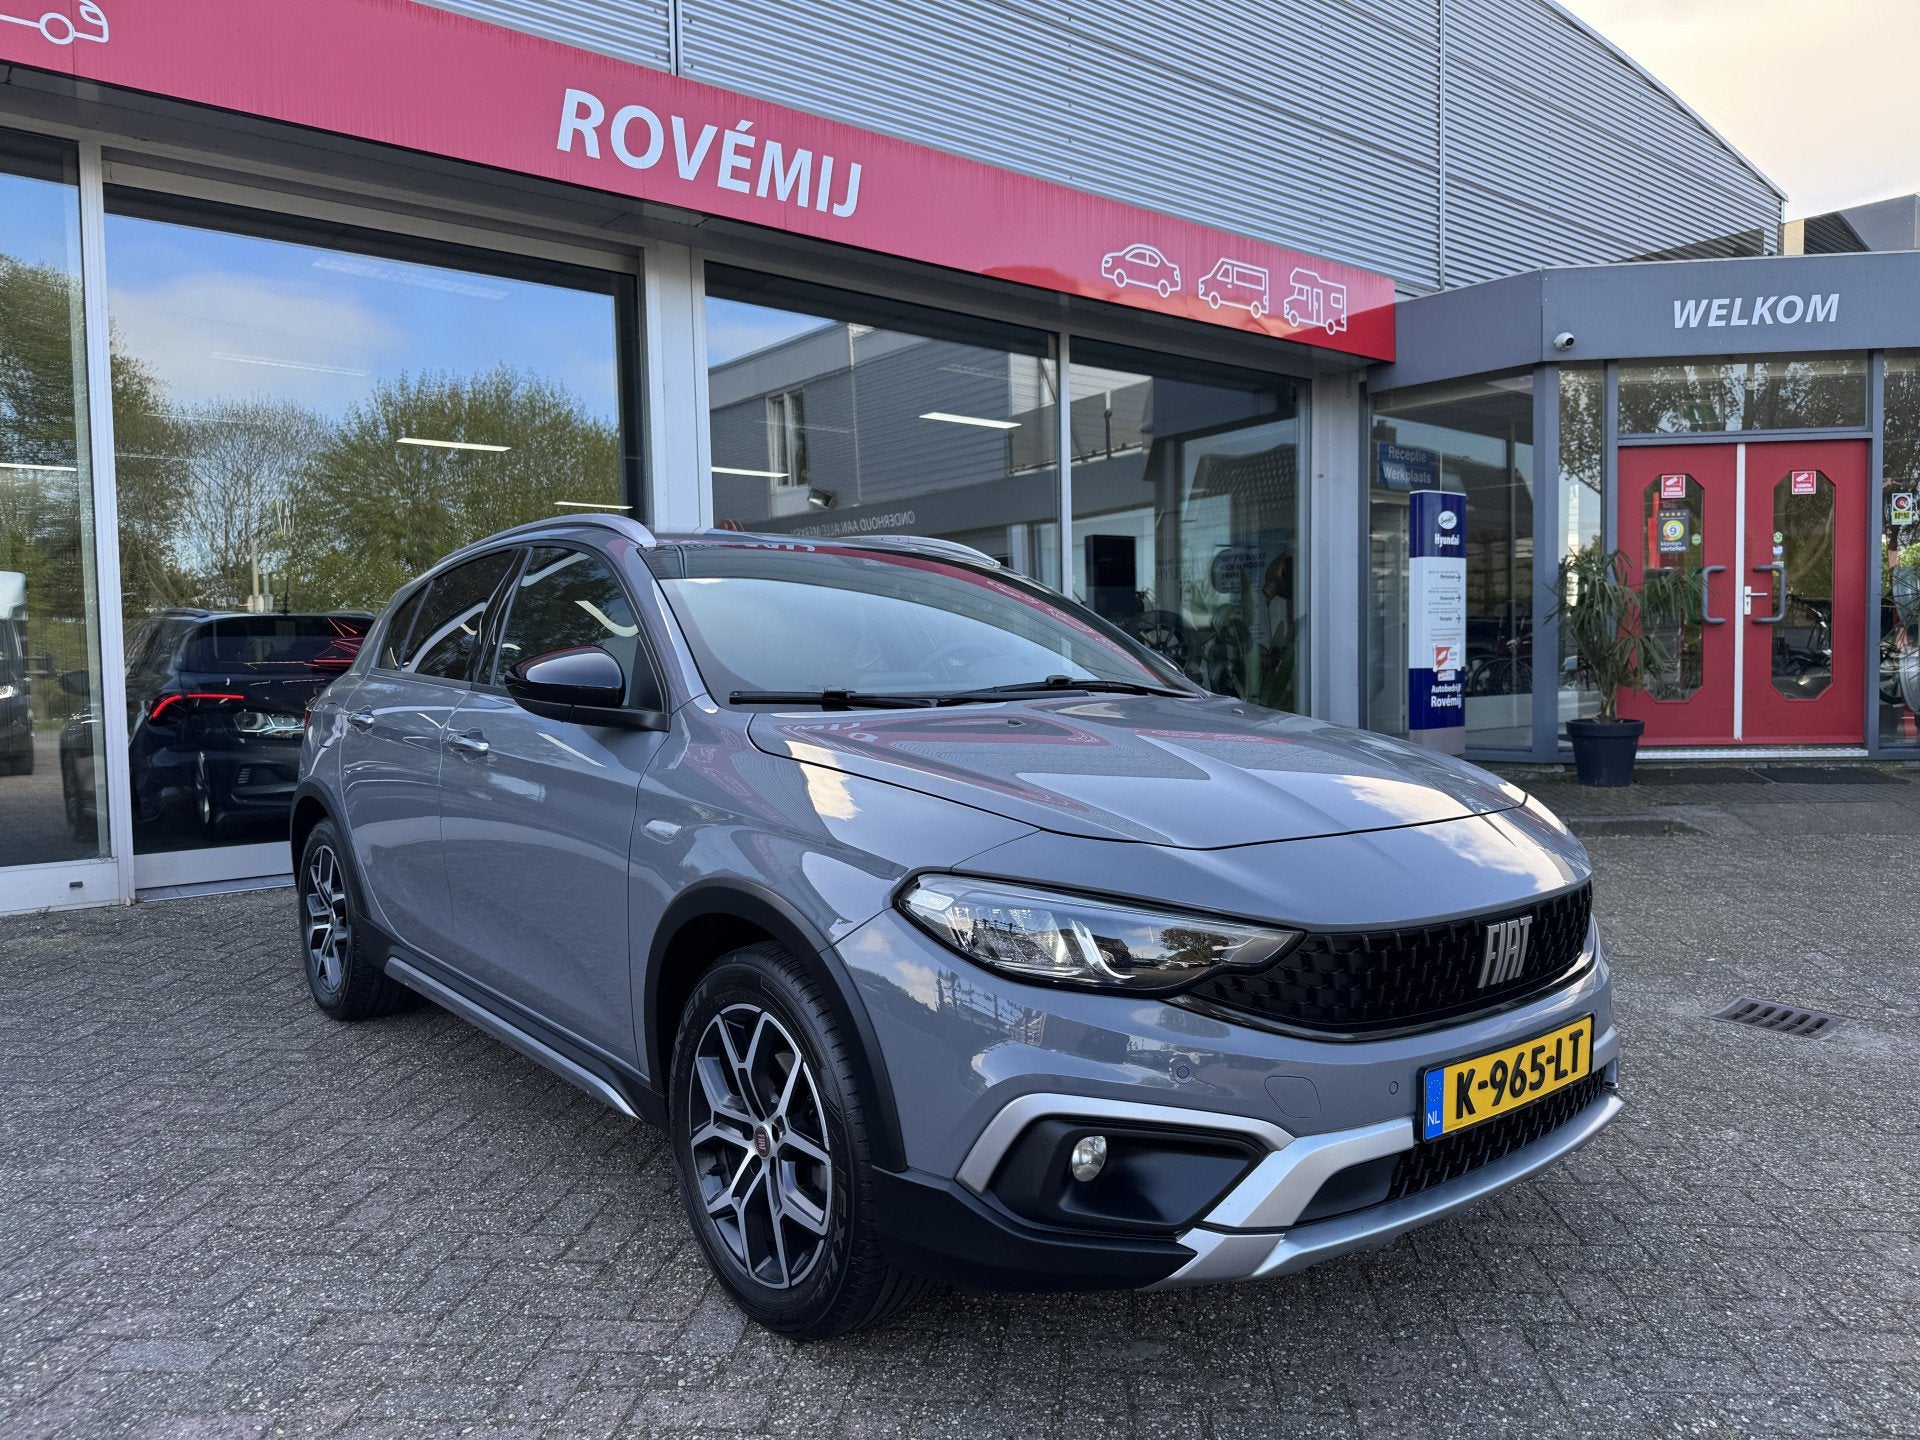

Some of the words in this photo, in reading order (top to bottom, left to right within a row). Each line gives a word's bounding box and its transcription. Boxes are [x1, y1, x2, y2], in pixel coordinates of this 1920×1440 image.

[557, 88, 862, 218] ROVÉMIJ
[1673, 293, 1840, 329] WELKOM
[1388, 445, 1427, 463] Receptie
[1383, 464, 1431, 484] Werkplaats
[1669, 526, 1677, 536] 9
[1434, 533, 1460, 548] Hyundai
[1431, 683, 1462, 695] Autobedrijf
[1430, 694, 1462, 709] Rovémij
[1477, 915, 1533, 989] FIAT
[1456, 1028, 1584, 1120] K-965-LT
[1427, 1110, 1441, 1127] NL
[757, 1133, 767, 1151] FIAT
